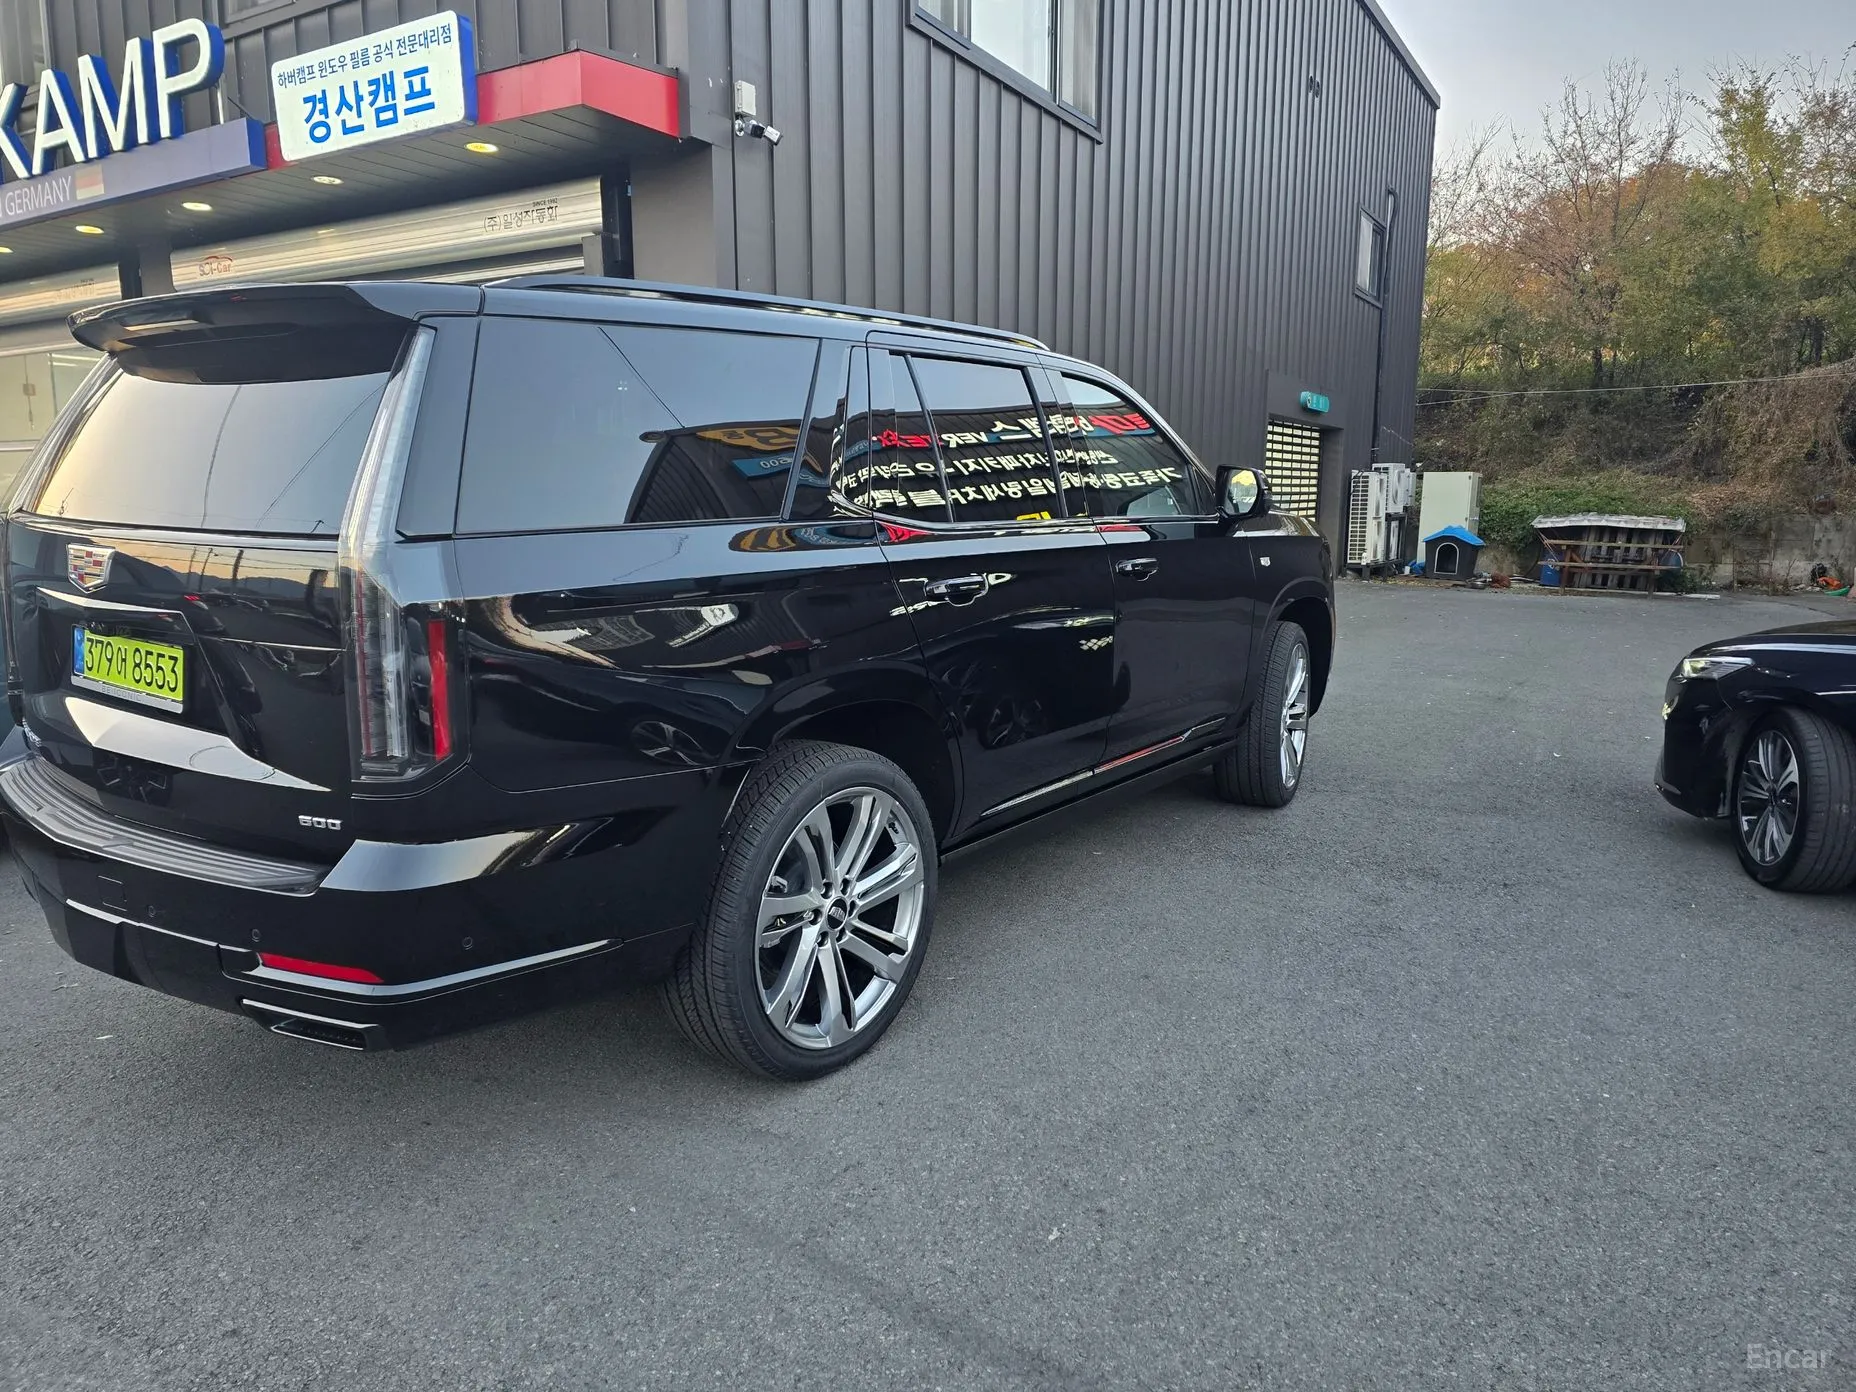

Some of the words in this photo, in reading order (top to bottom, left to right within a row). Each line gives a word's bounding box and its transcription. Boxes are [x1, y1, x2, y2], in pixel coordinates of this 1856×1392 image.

[277, 63, 317, 89] 하버캠프
[318, 54, 348, 79] 윈도우
[349, 47, 371, 70] 필름
[372, 39, 394, 64] 공식
[396, 23, 452, 57] 전문대리점
[302, 65, 436, 144] 경산캠프
[5, 176, 72, 217] GERMANY
[86, 637, 127, 680] 379어
[132, 647, 179, 693] 8553
[298, 814, 342, 831] 600
